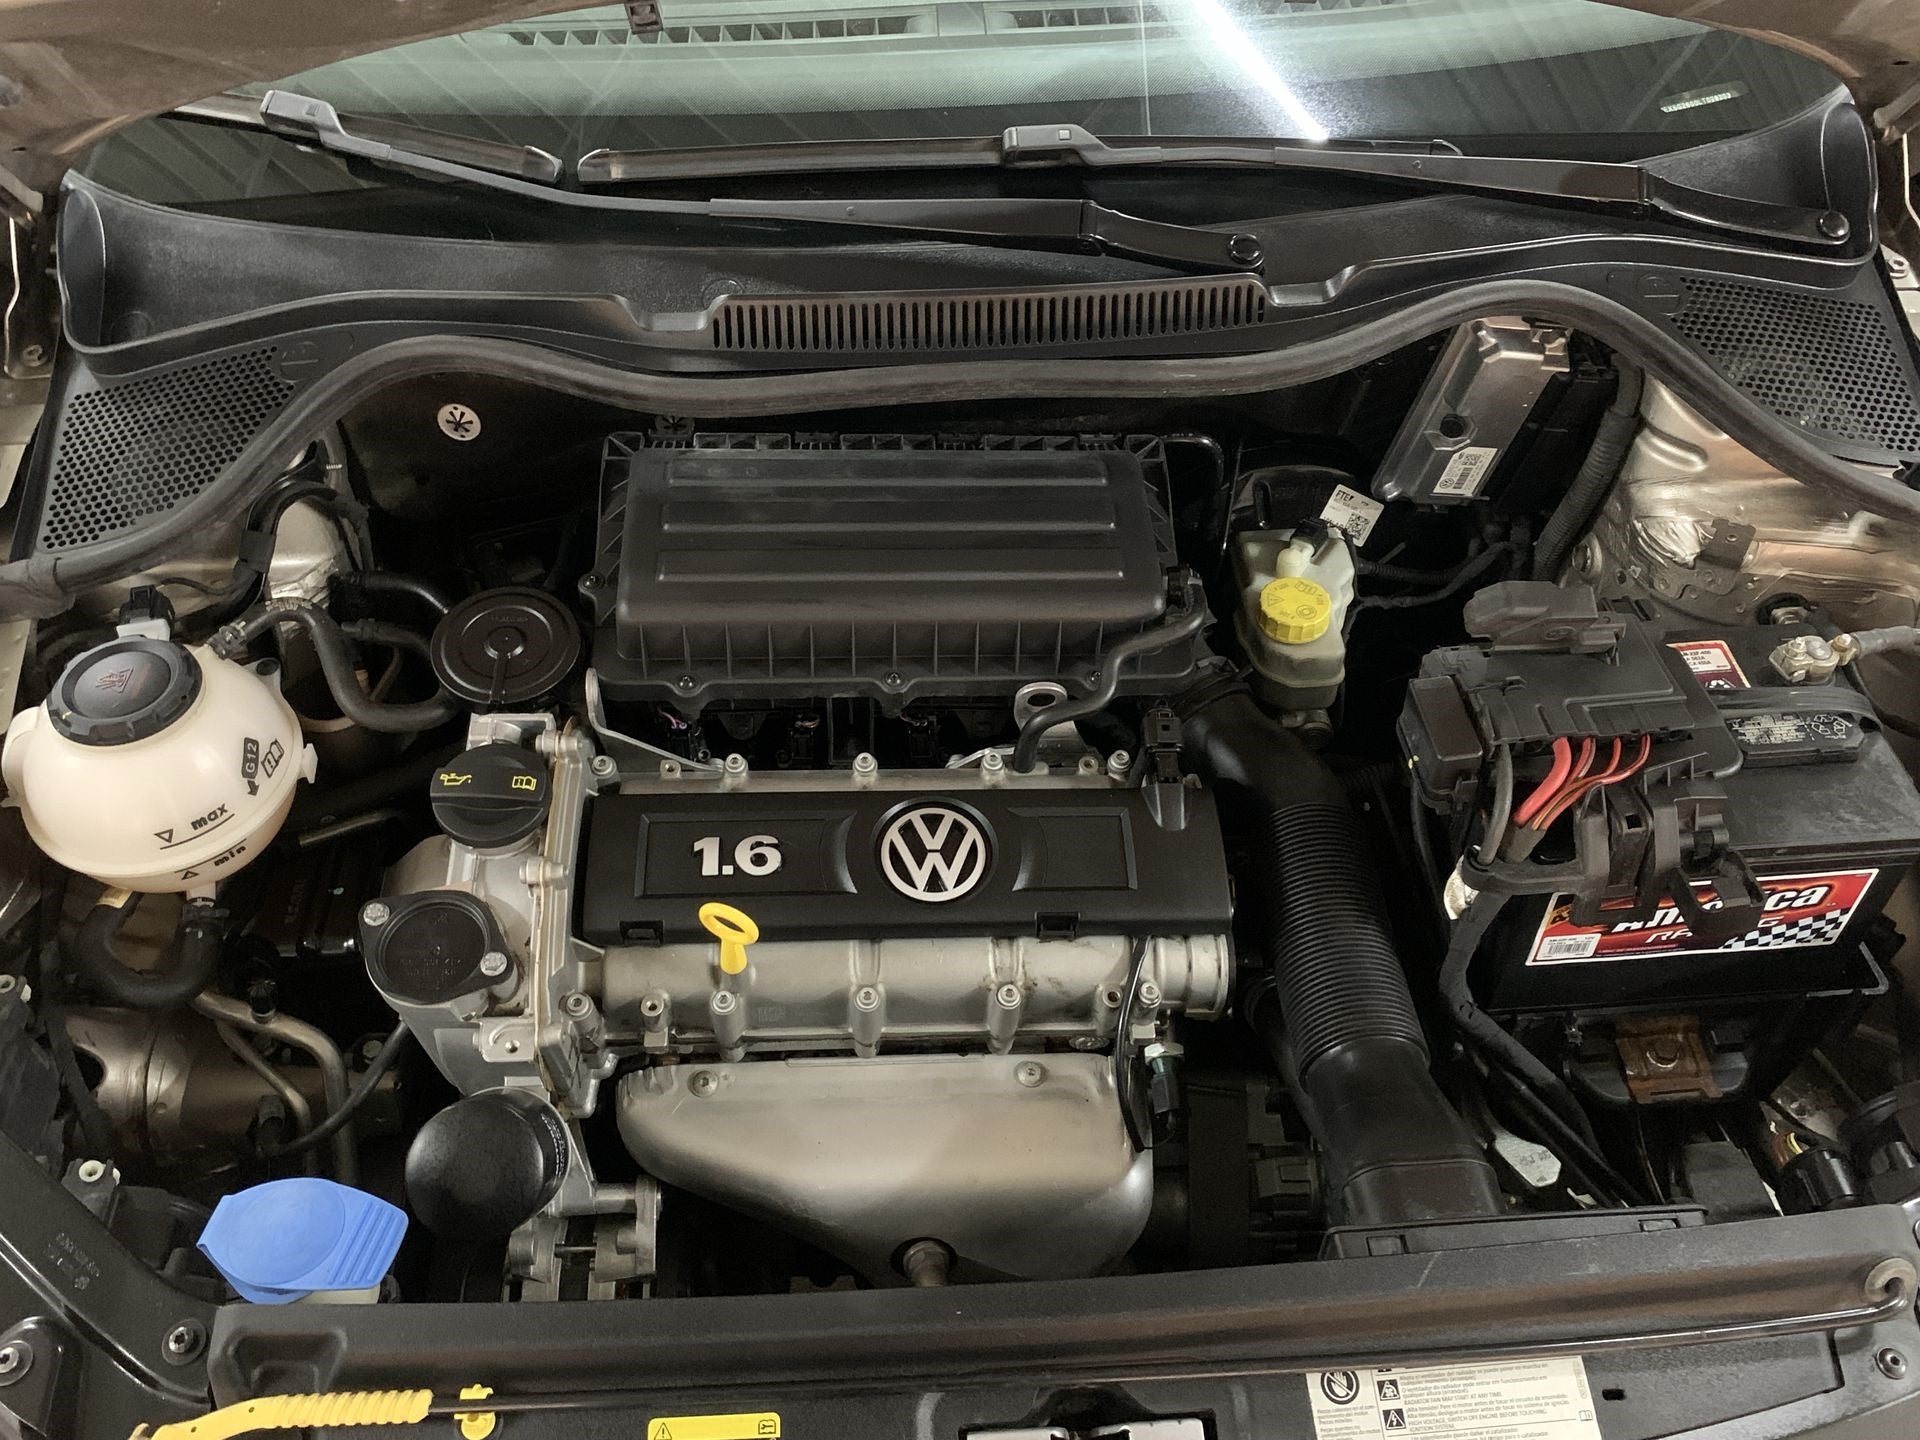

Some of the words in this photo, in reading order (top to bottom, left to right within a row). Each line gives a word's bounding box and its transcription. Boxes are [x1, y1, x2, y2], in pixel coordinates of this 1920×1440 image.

[245, 742, 257, 773] G12
[190, 803, 228, 830] max
[213, 845, 246, 866] min
[692, 834, 783, 876] 1.6
